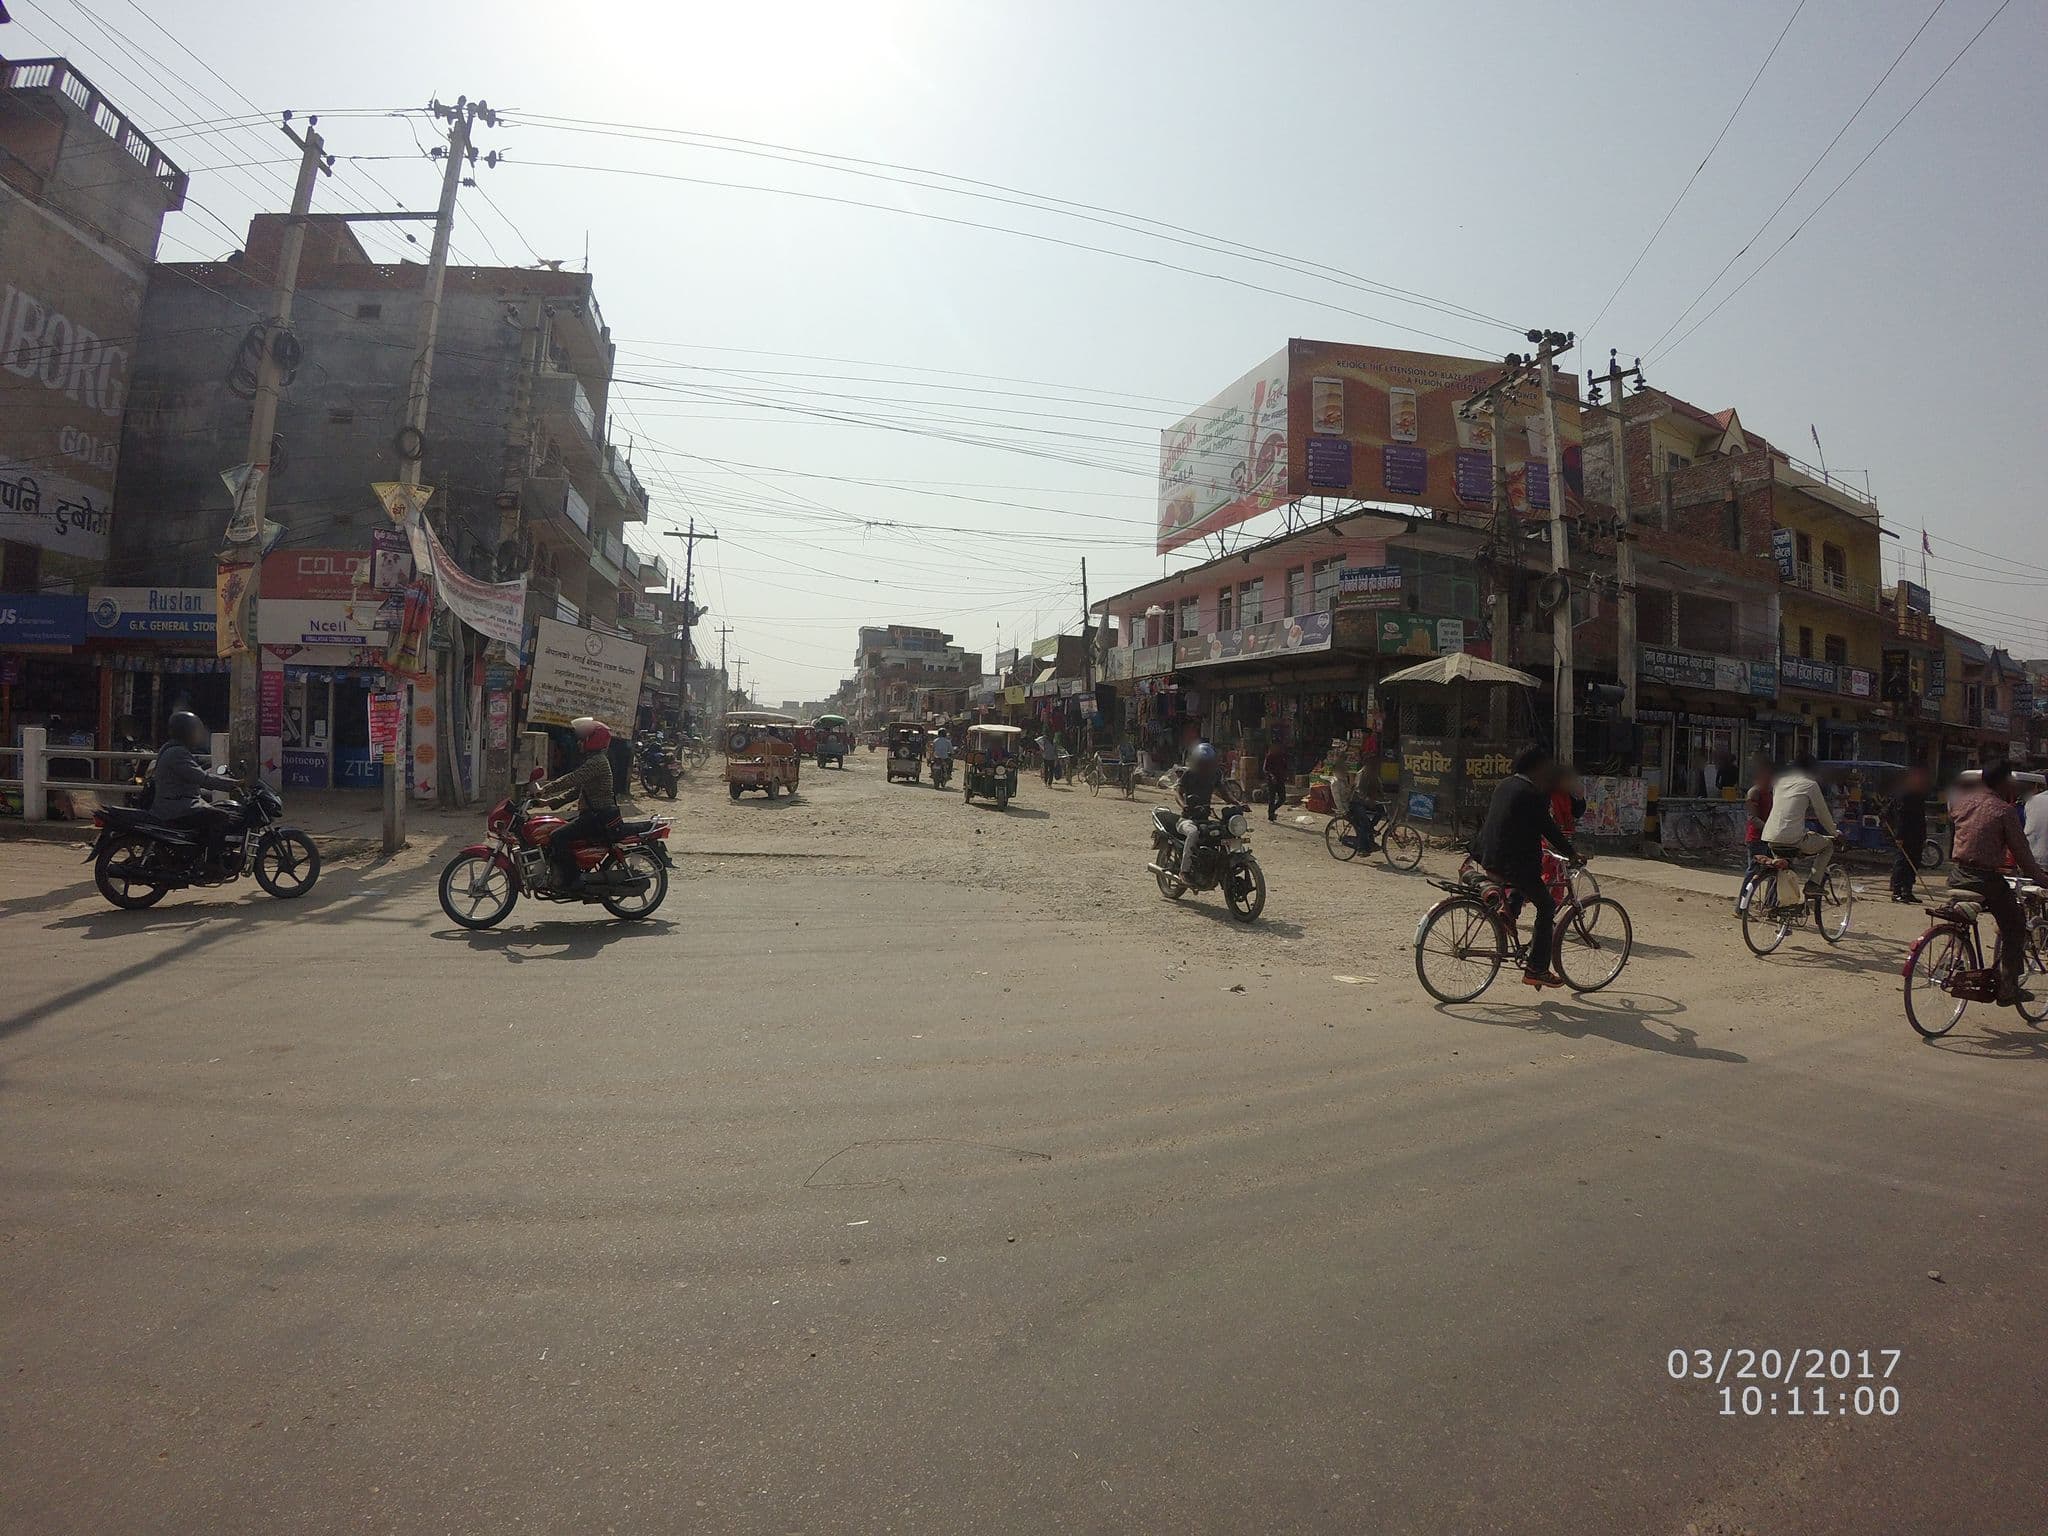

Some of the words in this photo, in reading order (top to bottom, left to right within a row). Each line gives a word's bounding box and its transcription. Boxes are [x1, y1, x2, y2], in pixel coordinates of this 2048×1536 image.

[1336, 360, 1367, 370] REJOICE
[1384, 364, 1426, 377] EXTENSION
[1428, 369, 1439, 377] OF
[1414, 378, 1443, 388] FUSION
[149, 589, 201, 611] Ruslan
[150, 621, 189, 633] GENERAL
[193, 622, 217, 633] STOR
[311, 620, 347, 632] Ncell
[345, 760, 374, 777] ZTE
[292, 773, 311, 783] Fax
